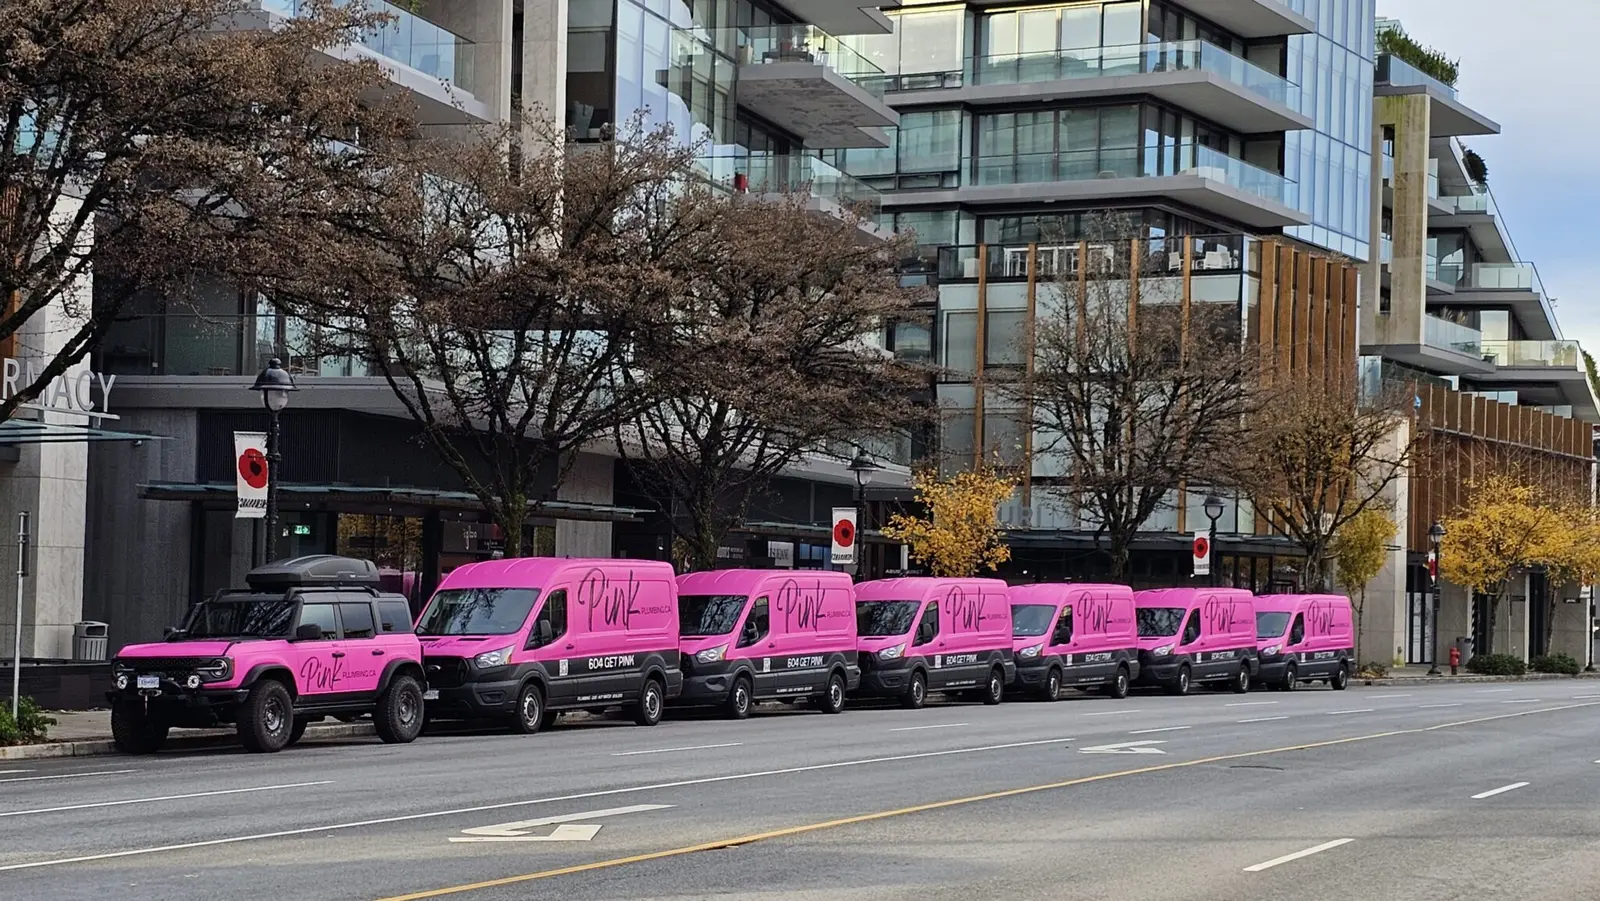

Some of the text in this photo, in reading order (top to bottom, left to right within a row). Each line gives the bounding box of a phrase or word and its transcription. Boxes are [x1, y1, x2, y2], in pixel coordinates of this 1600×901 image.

[578, 567, 640, 632] Pink
[777, 578, 826, 634] Pink
[945, 585, 986, 634] Pink
[1077, 591, 1113, 635] Pink
[300, 656, 377, 692] Pink PLUMBING.CA
[588, 654, 635, 670] 604 GET PINK
[787, 655, 823, 668] 604 GET PINK
